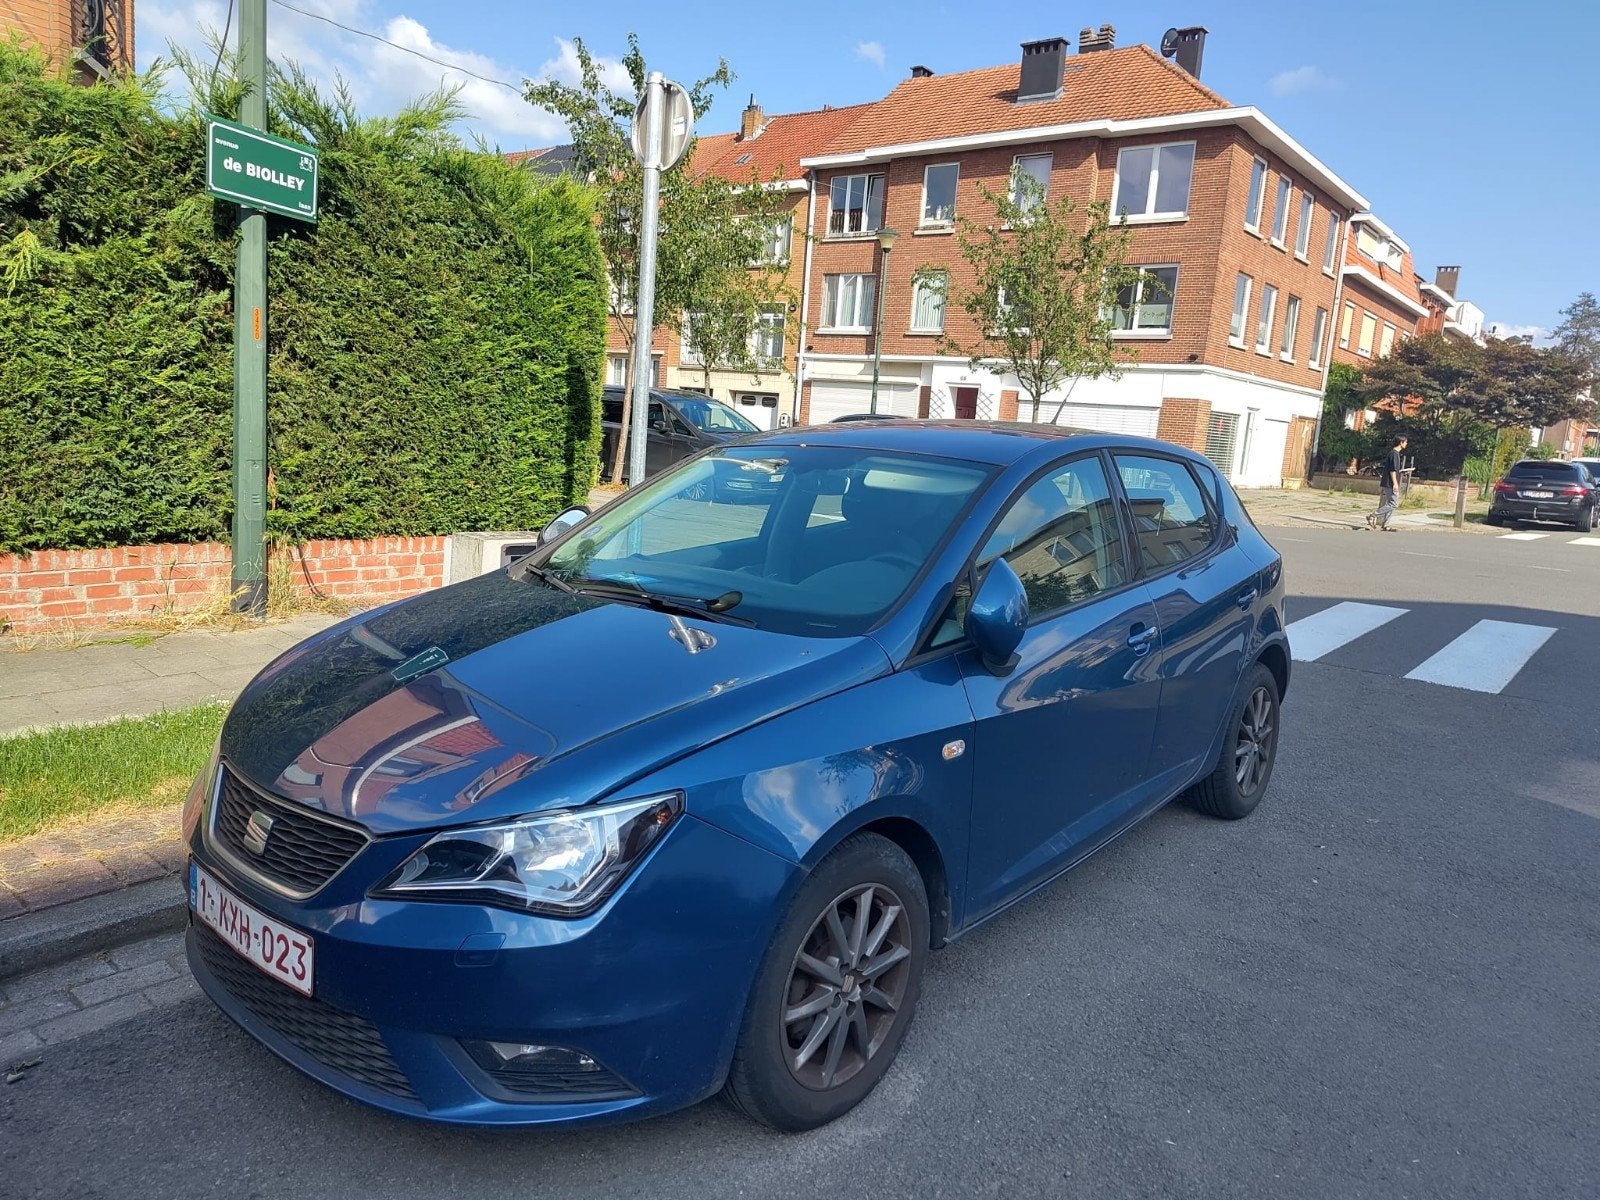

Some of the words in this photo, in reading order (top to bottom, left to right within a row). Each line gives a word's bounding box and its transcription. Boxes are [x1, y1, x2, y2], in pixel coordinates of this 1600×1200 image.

[215, 137, 239, 150] avenue
[223, 157, 242, 173] de
[246, 162, 305, 191] BIOLLEY
